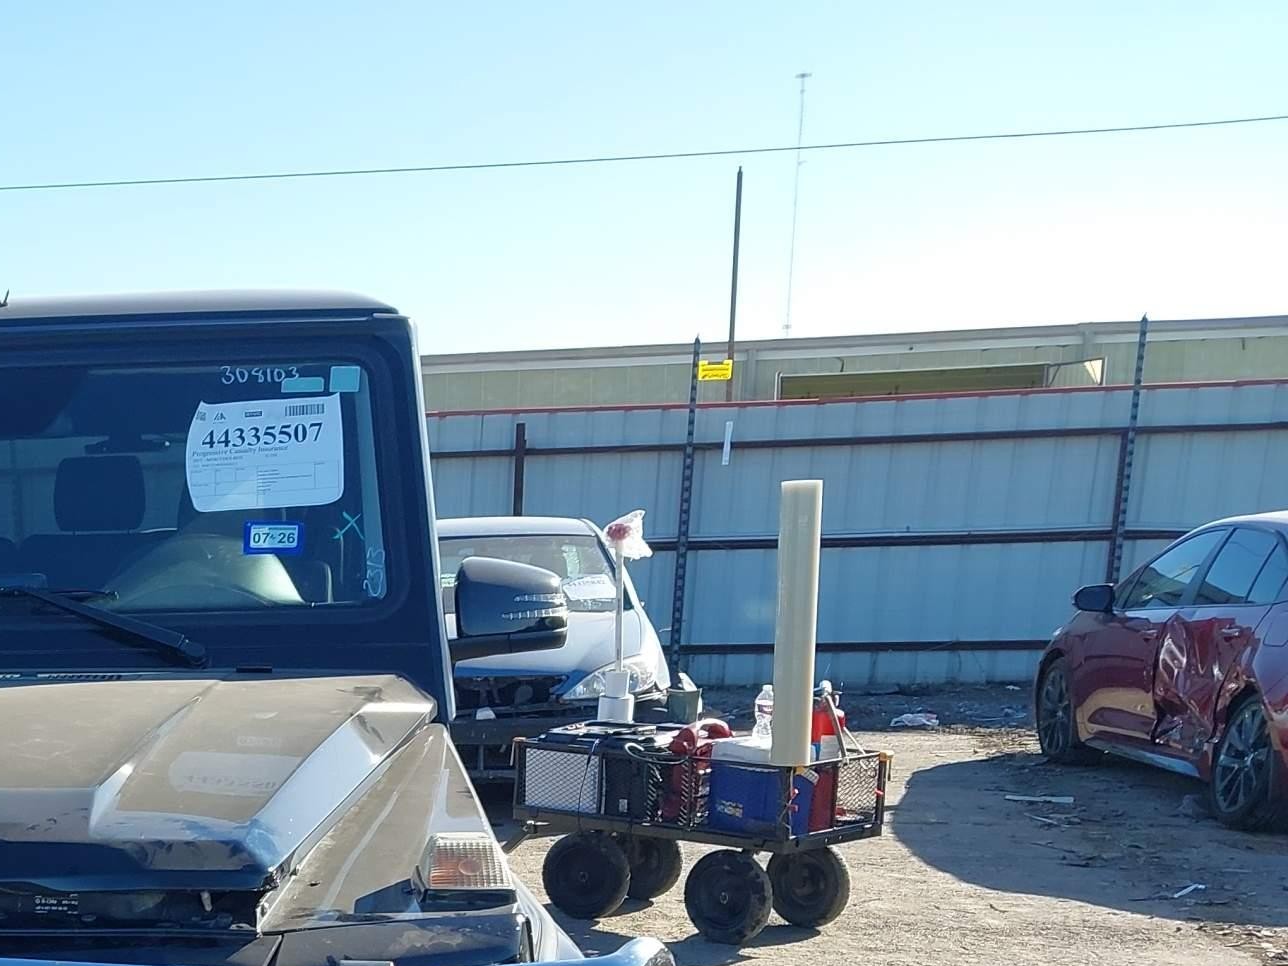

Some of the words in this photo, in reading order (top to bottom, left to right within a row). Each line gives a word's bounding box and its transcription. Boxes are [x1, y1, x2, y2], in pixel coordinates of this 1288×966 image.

[219, 365, 300, 385] 308103
[201, 421, 324, 449] 44335507
[252, 532, 271, 544] 07
[277, 532, 296, 544] 26
